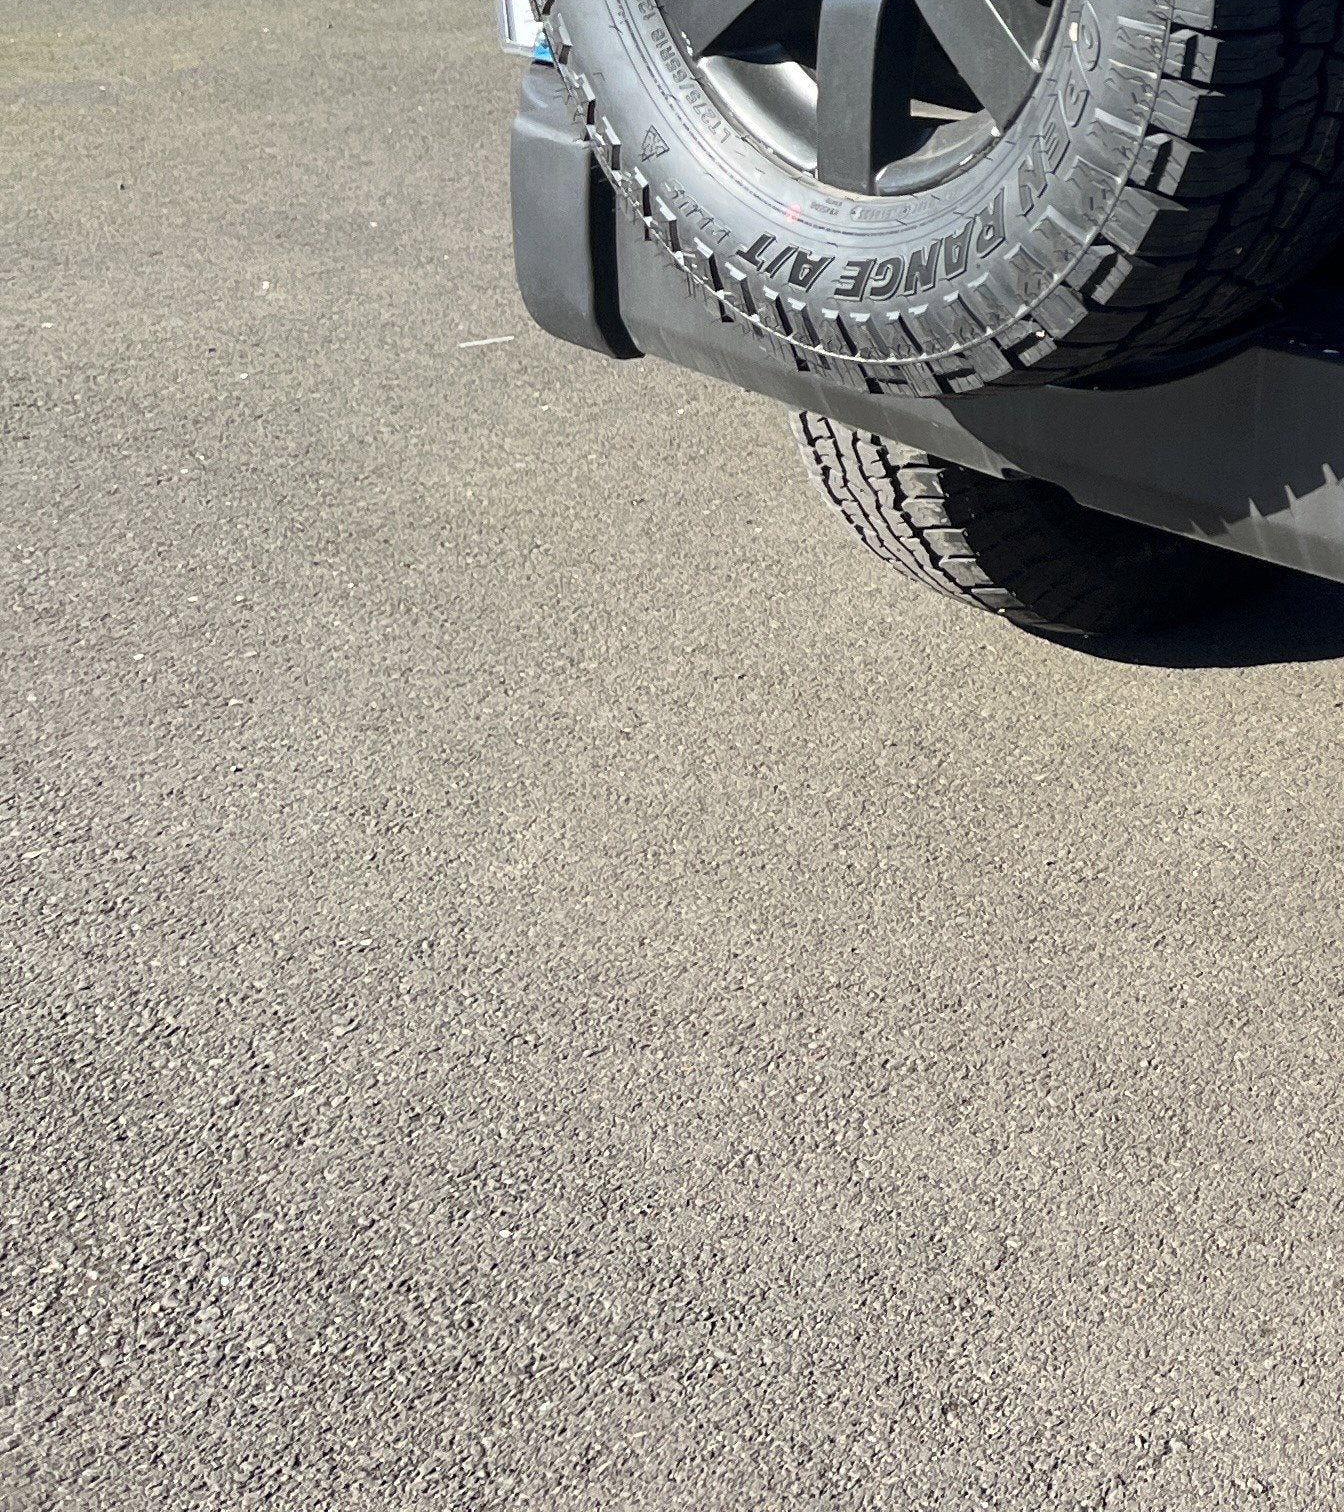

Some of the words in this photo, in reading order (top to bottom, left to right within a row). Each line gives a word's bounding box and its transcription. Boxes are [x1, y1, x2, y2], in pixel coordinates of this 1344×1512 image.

[650, 28, 732, 144] LT275/65R18
[1017, 0, 1101, 217] OPEN
[735, 232, 835, 293] A/T
[833, 186, 1005, 302] RANGE
